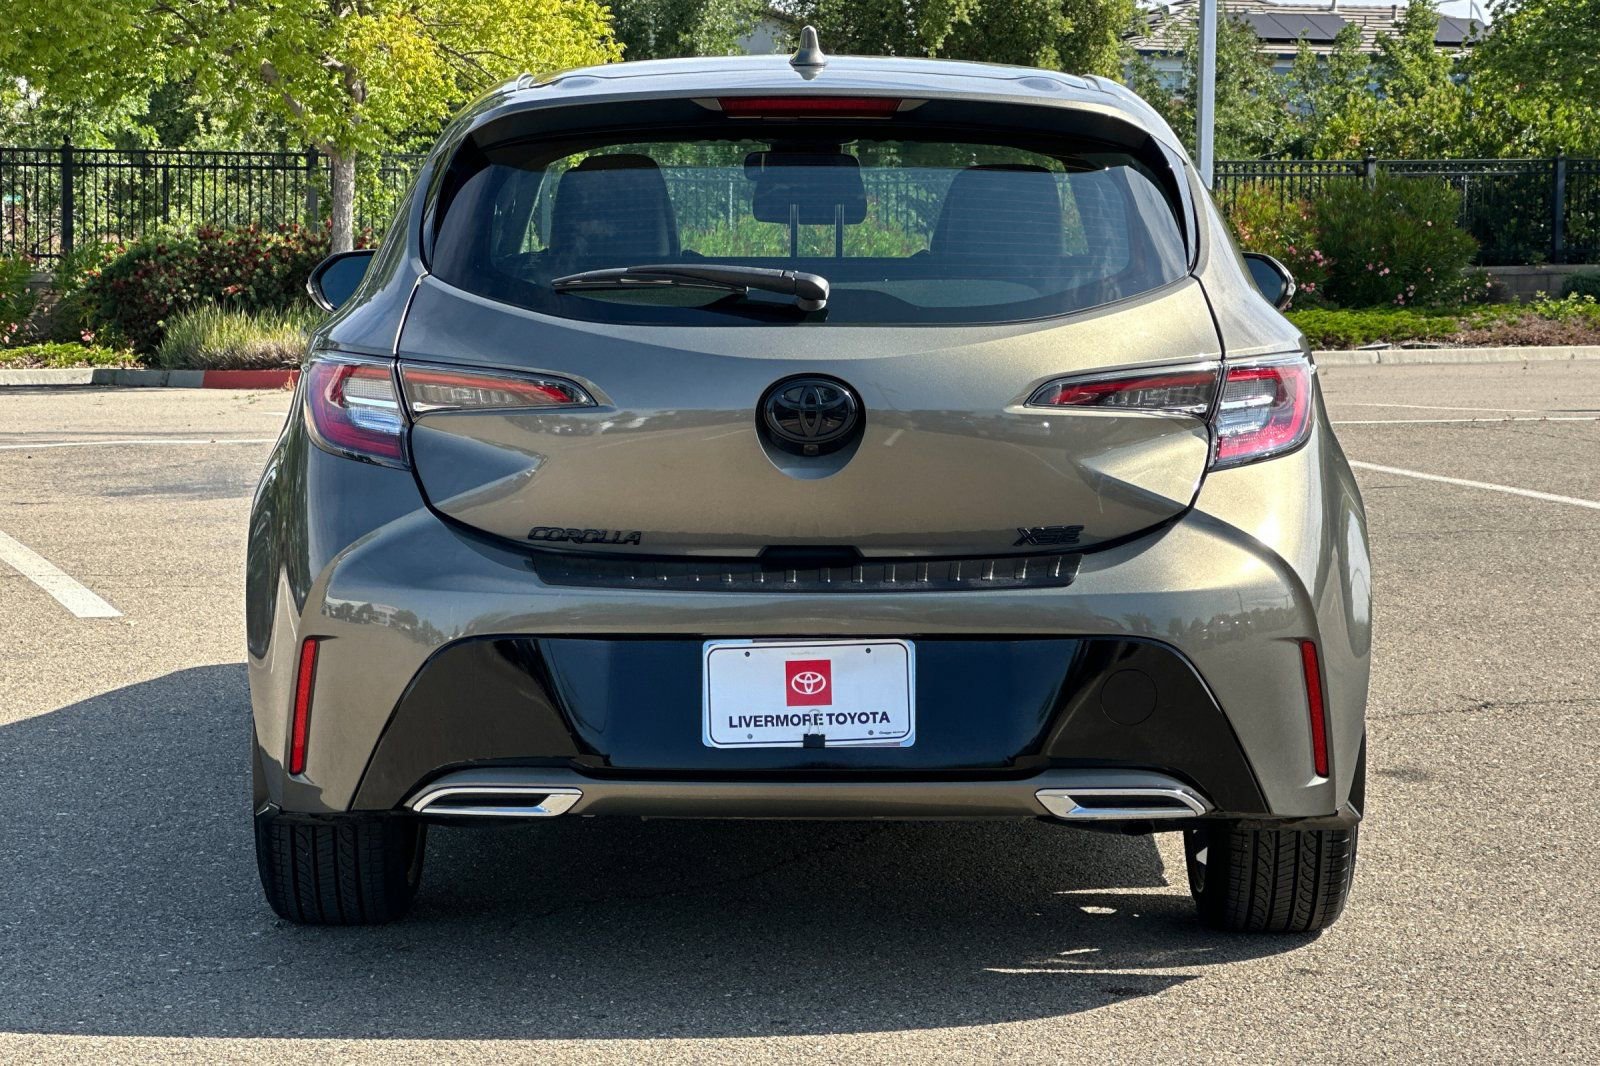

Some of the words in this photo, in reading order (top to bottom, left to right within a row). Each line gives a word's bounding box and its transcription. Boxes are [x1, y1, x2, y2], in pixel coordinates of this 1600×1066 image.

[527, 526, 641, 545] COROLLA
[1012, 525, 1085, 547] XSE
[728, 713, 824, 728] LIVERMORE
[826, 711, 891, 726] TOYOTA
